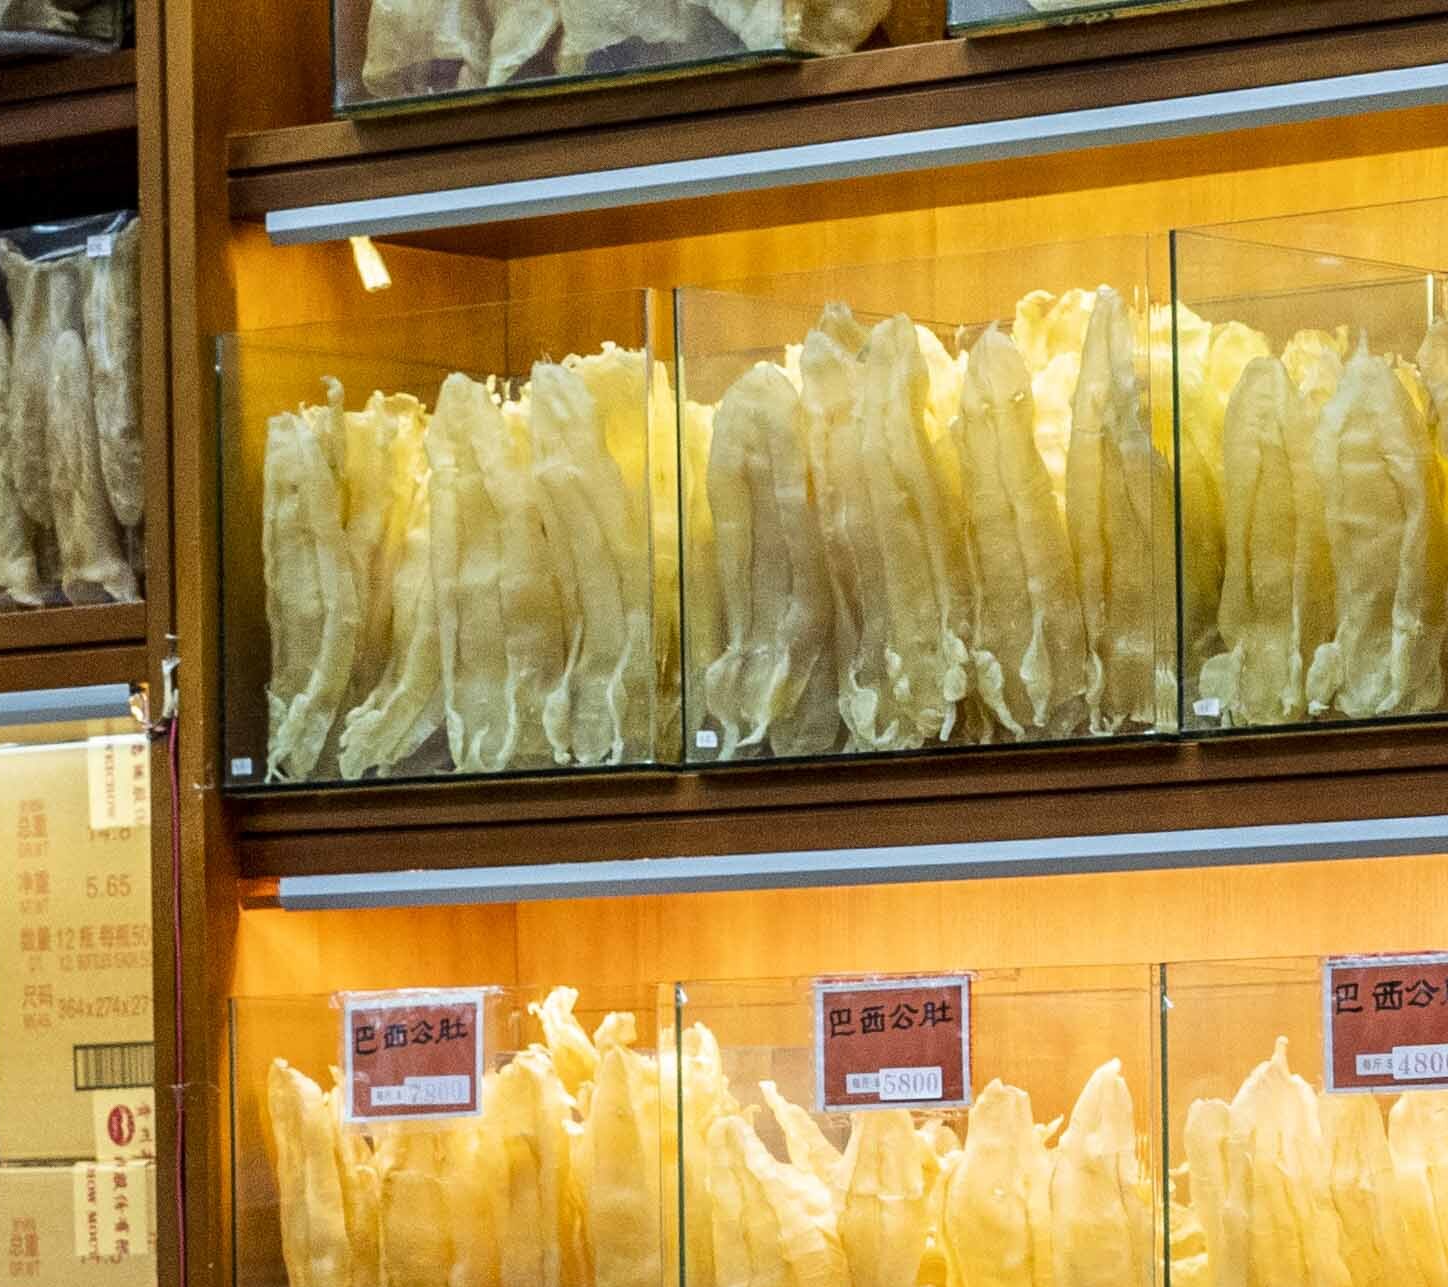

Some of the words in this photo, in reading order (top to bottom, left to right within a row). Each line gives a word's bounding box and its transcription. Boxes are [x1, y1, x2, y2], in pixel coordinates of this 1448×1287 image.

[86, 875, 131, 898] 5.65
[829, 1000, 954, 1038] 巴西公肚
[355, 1018, 468, 1055] 巴西公肚
[883, 1072, 938, 1095] 5800
